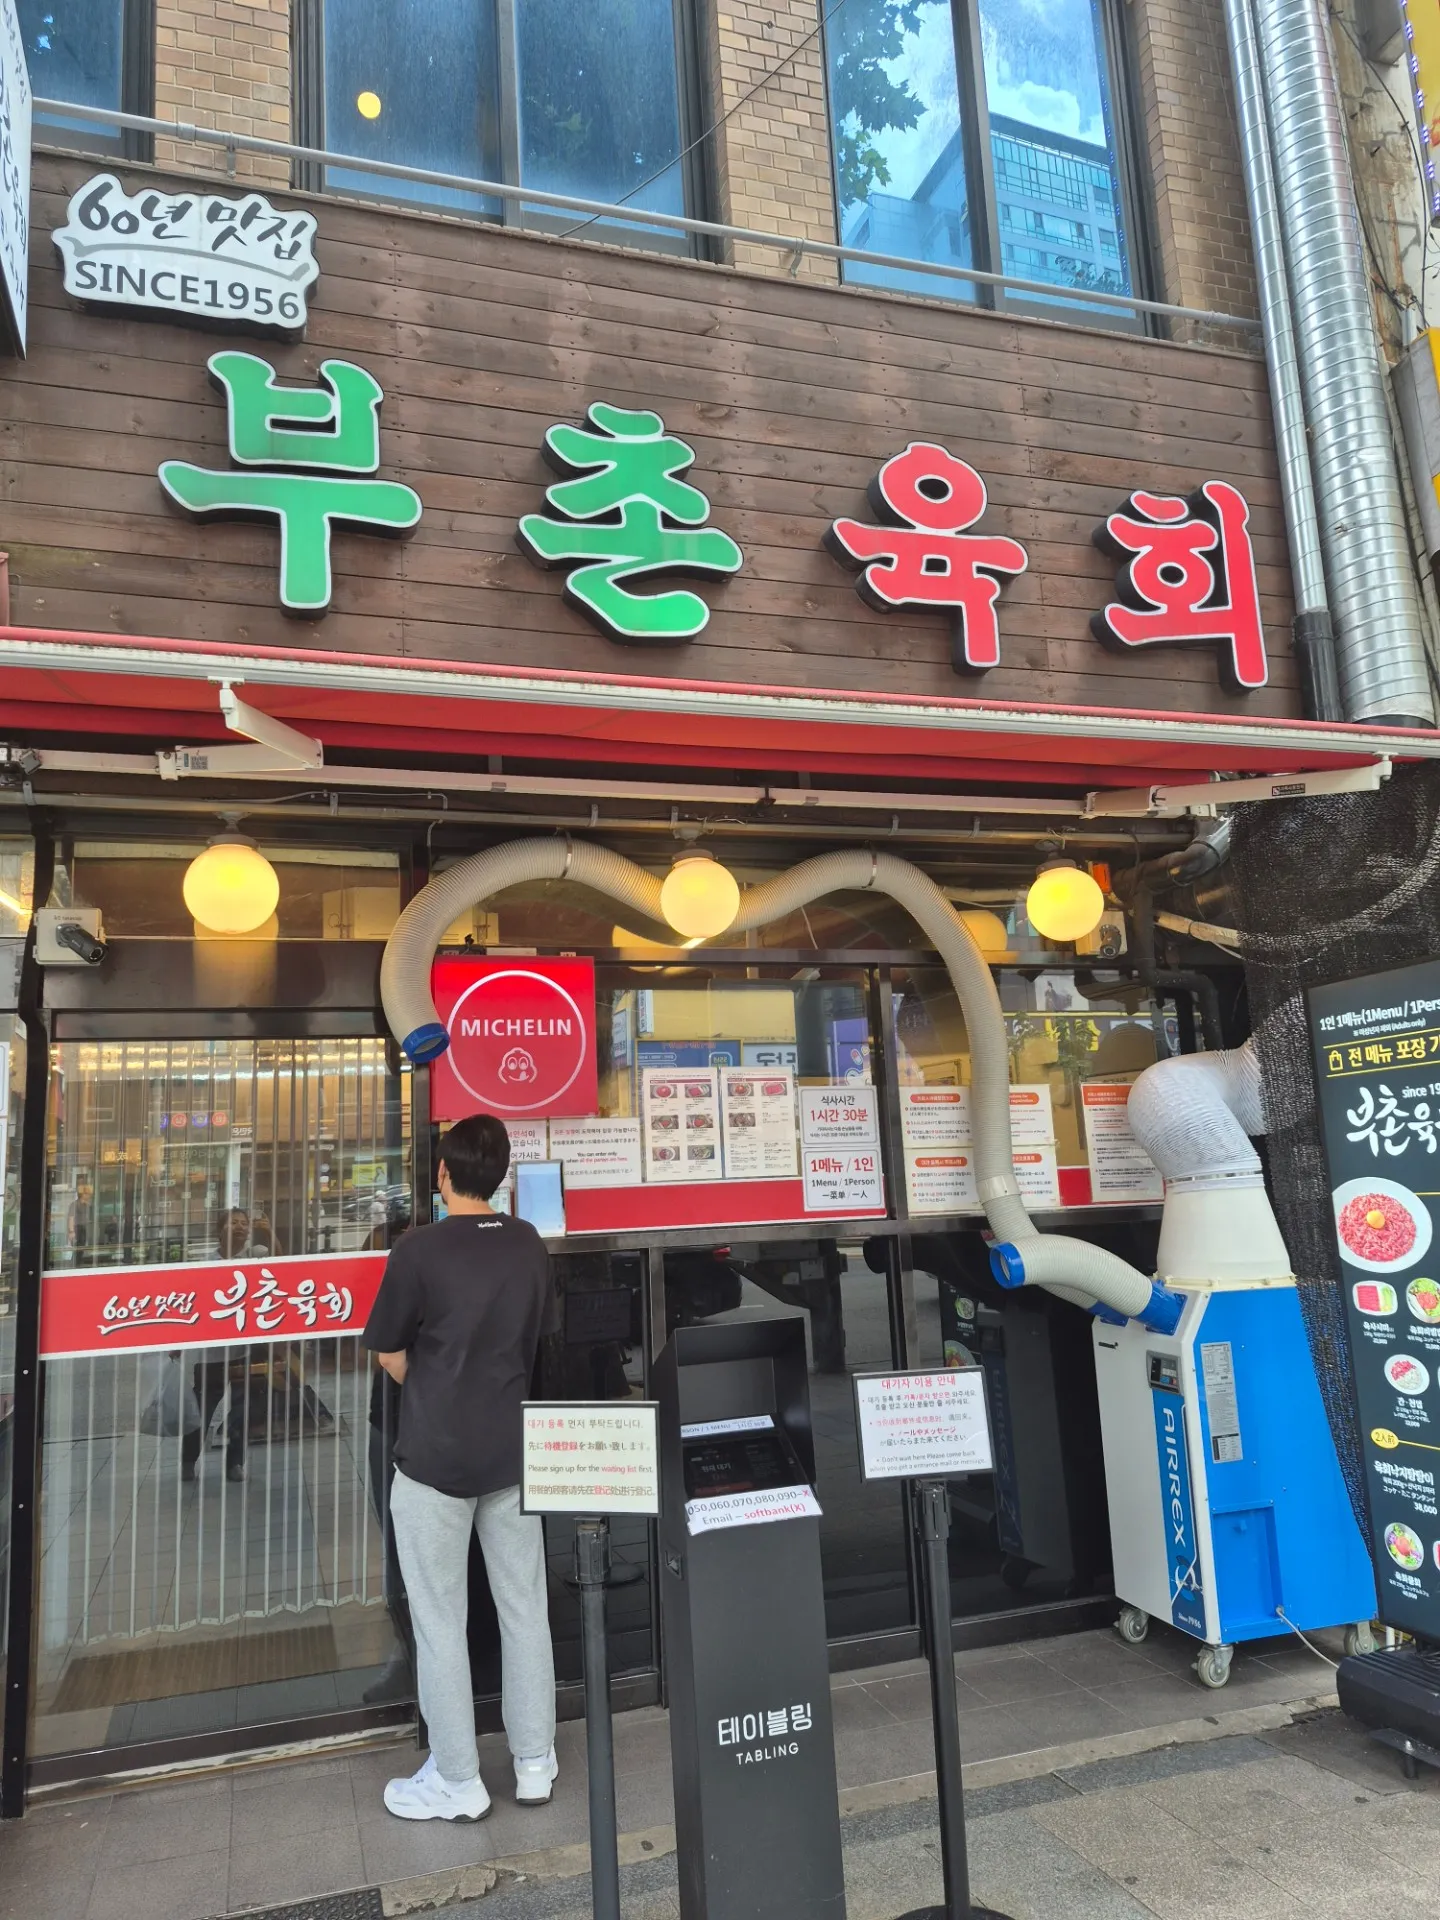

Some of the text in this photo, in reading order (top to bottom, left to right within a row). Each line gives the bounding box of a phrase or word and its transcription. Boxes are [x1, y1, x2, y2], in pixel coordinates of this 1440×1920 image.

[78, 181, 309, 261] 60년 맛집
[74, 260, 300, 320] SINCE1956
[461, 1019, 571, 1037] MICHELIN
[1320, 1015, 1335, 1031] 1인
[1348, 1046, 1363, 1068] 전
[1365, 1044, 1394, 1064] 메뉴
[1396, 1037, 1426, 1059] 포장
[821, 1096, 855, 1106] 식사시간
[1402, 1086, 1427, 1099] since
[811, 1108, 868, 1122] 1시간 30분
[1346, 1084, 1440, 1157] 부촌육
[811, 1158, 843, 1173] 1메뉴
[854, 1157, 874, 1172] 1인
[811, 1179, 837, 1187] 1Menu
[844, 1178, 876, 1186] 1Person
[102, 1268, 354, 1333] 60년 맛집 부촌육회
[881, 1375, 956, 1389] 대기자 이용 안내
[528, 1419, 544, 1429] 대기
[548, 1419, 564, 1429] 등록
[568, 1419, 585, 1429] 먼저
[1376, 1432, 1395, 1445] 2人前
[528, 1464, 548, 1473] Please
[550, 1464, 564, 1476] sign
[565, 1466, 575, 1475] up
[576, 1464, 587, 1472] for
[589, 1464, 599, 1472] the
[601, 1465, 625, 1475] waiting
[627, 1465, 637, 1473] list
[1162, 1407, 1187, 1549] AIRREX
[702, 1514, 733, 1526] Email
[744, 1503, 806, 1521] softbank(X)
[717, 1702, 813, 1746] 테이블링
[736, 1742, 799, 1765] TABLING
